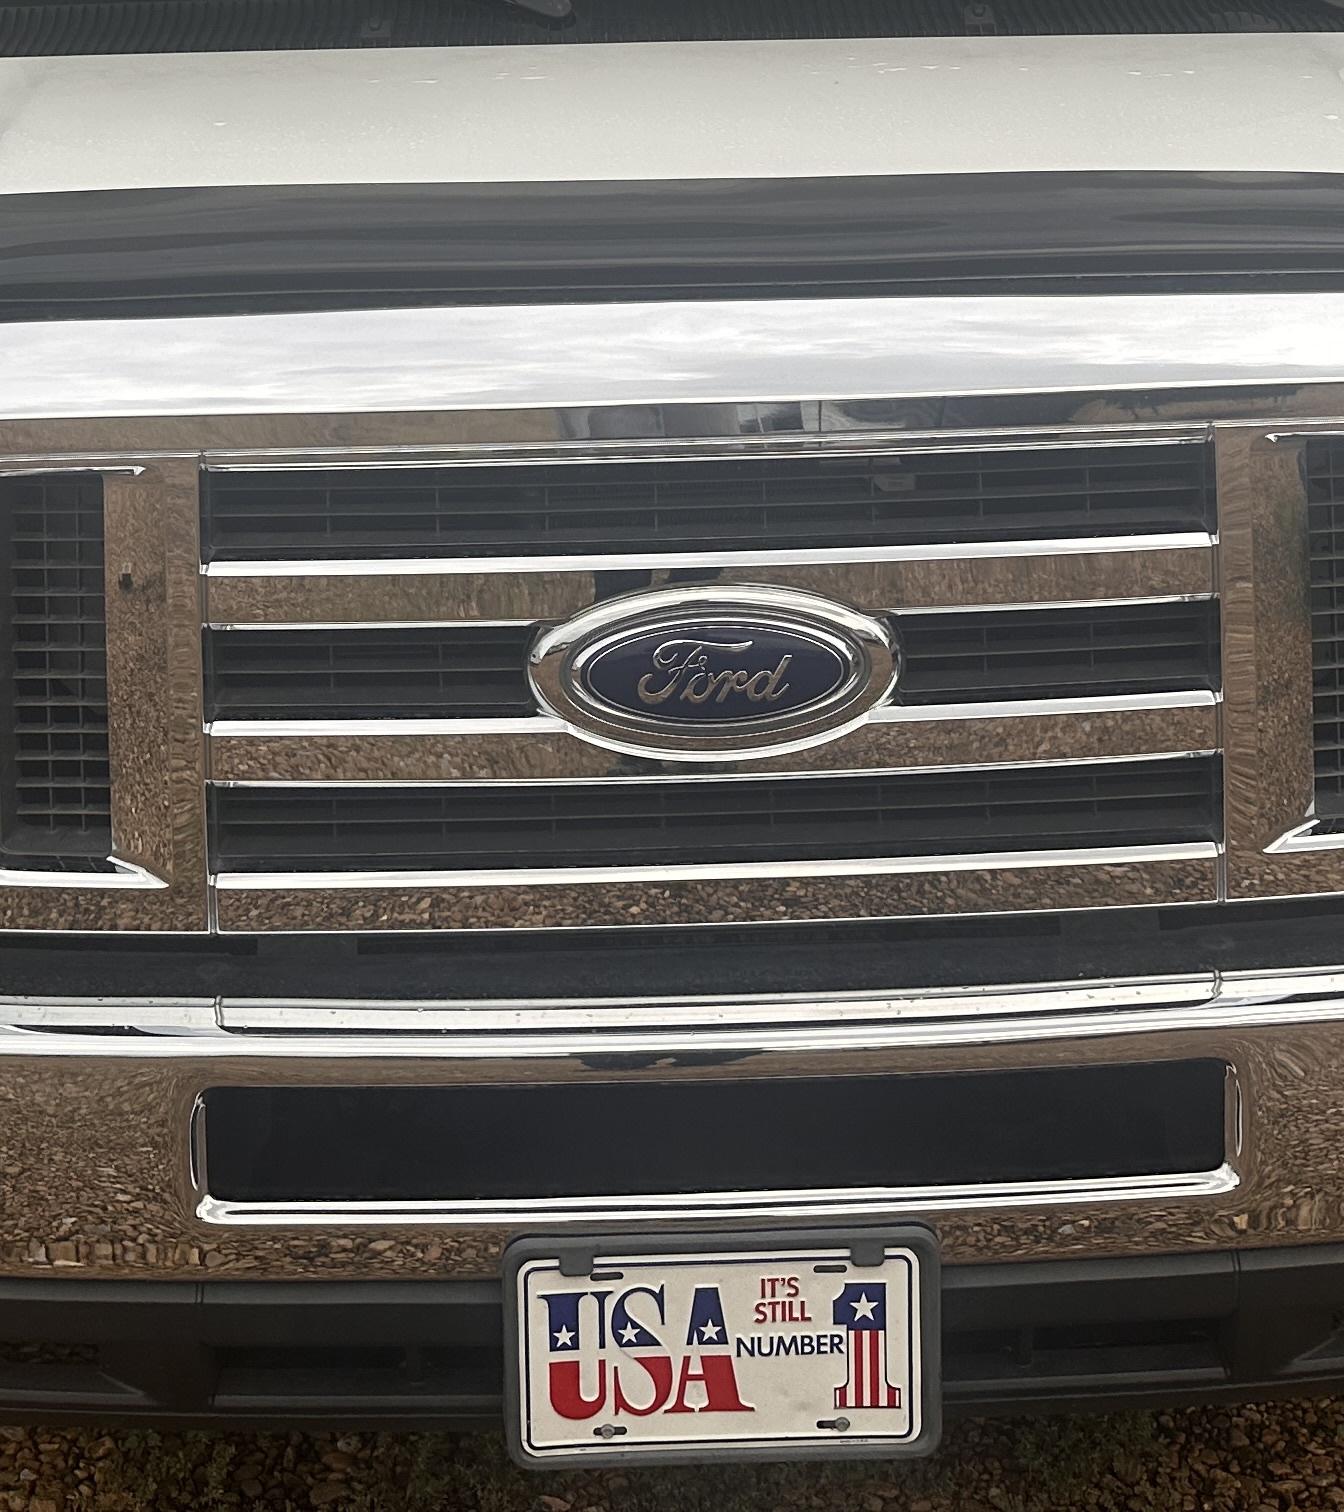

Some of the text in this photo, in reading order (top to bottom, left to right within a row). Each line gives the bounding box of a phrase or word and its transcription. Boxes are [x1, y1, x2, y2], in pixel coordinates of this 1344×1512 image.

[637, 639, 793, 705] Ford
[754, 1300, 813, 1324] STILL
[760, 1276, 800, 1299] IT'S
[537, 1284, 755, 1420] USA
[736, 1282, 902, 1410] NUMBER 1
